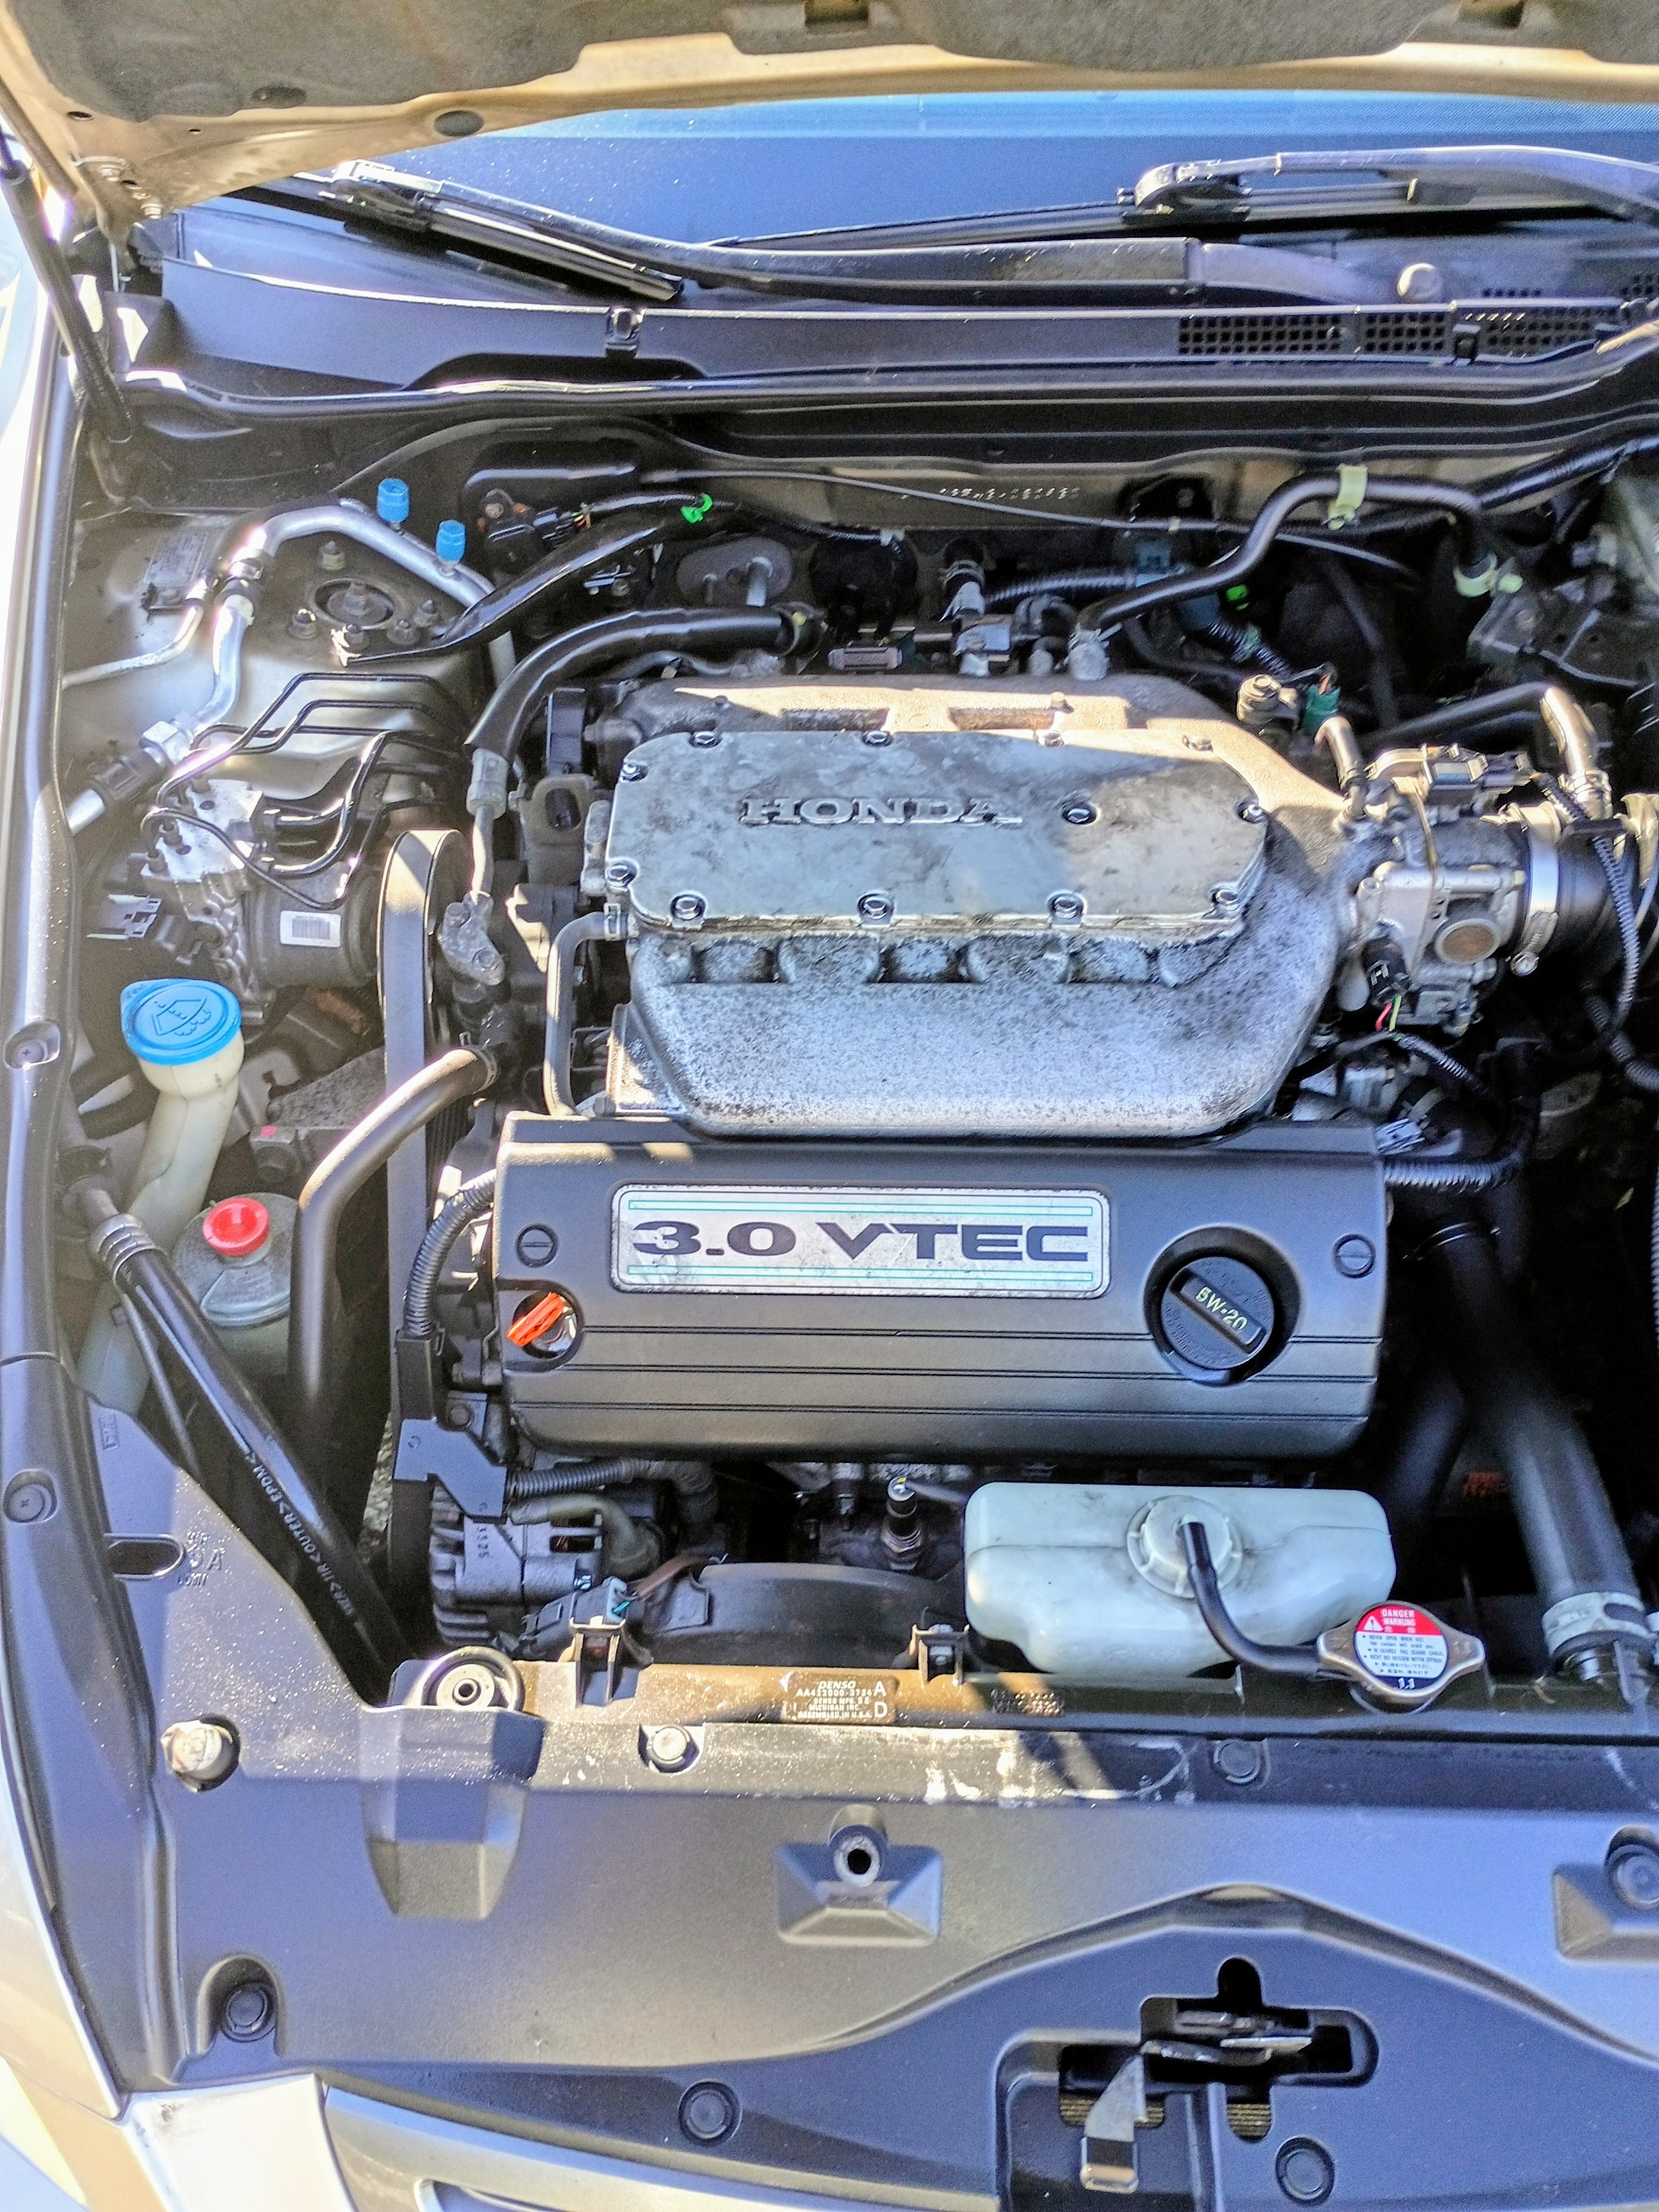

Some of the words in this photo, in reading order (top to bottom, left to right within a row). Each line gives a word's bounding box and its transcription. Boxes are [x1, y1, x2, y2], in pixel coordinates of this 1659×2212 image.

[740, 797, 1023, 826] HONDA
[633, 1220, 797, 1257] 3.0
[816, 1222, 1088, 1262] VTEC
[1195, 1286, 1247, 1331] 5W-20
[1381, 1609, 1414, 1617] DANGER
[1383, 1618, 1415, 1626] WARNUNG
[818, 1681, 857, 1689] DENSO
[873, 1681, 887, 1697] A
[874, 1701, 888, 1718] D
